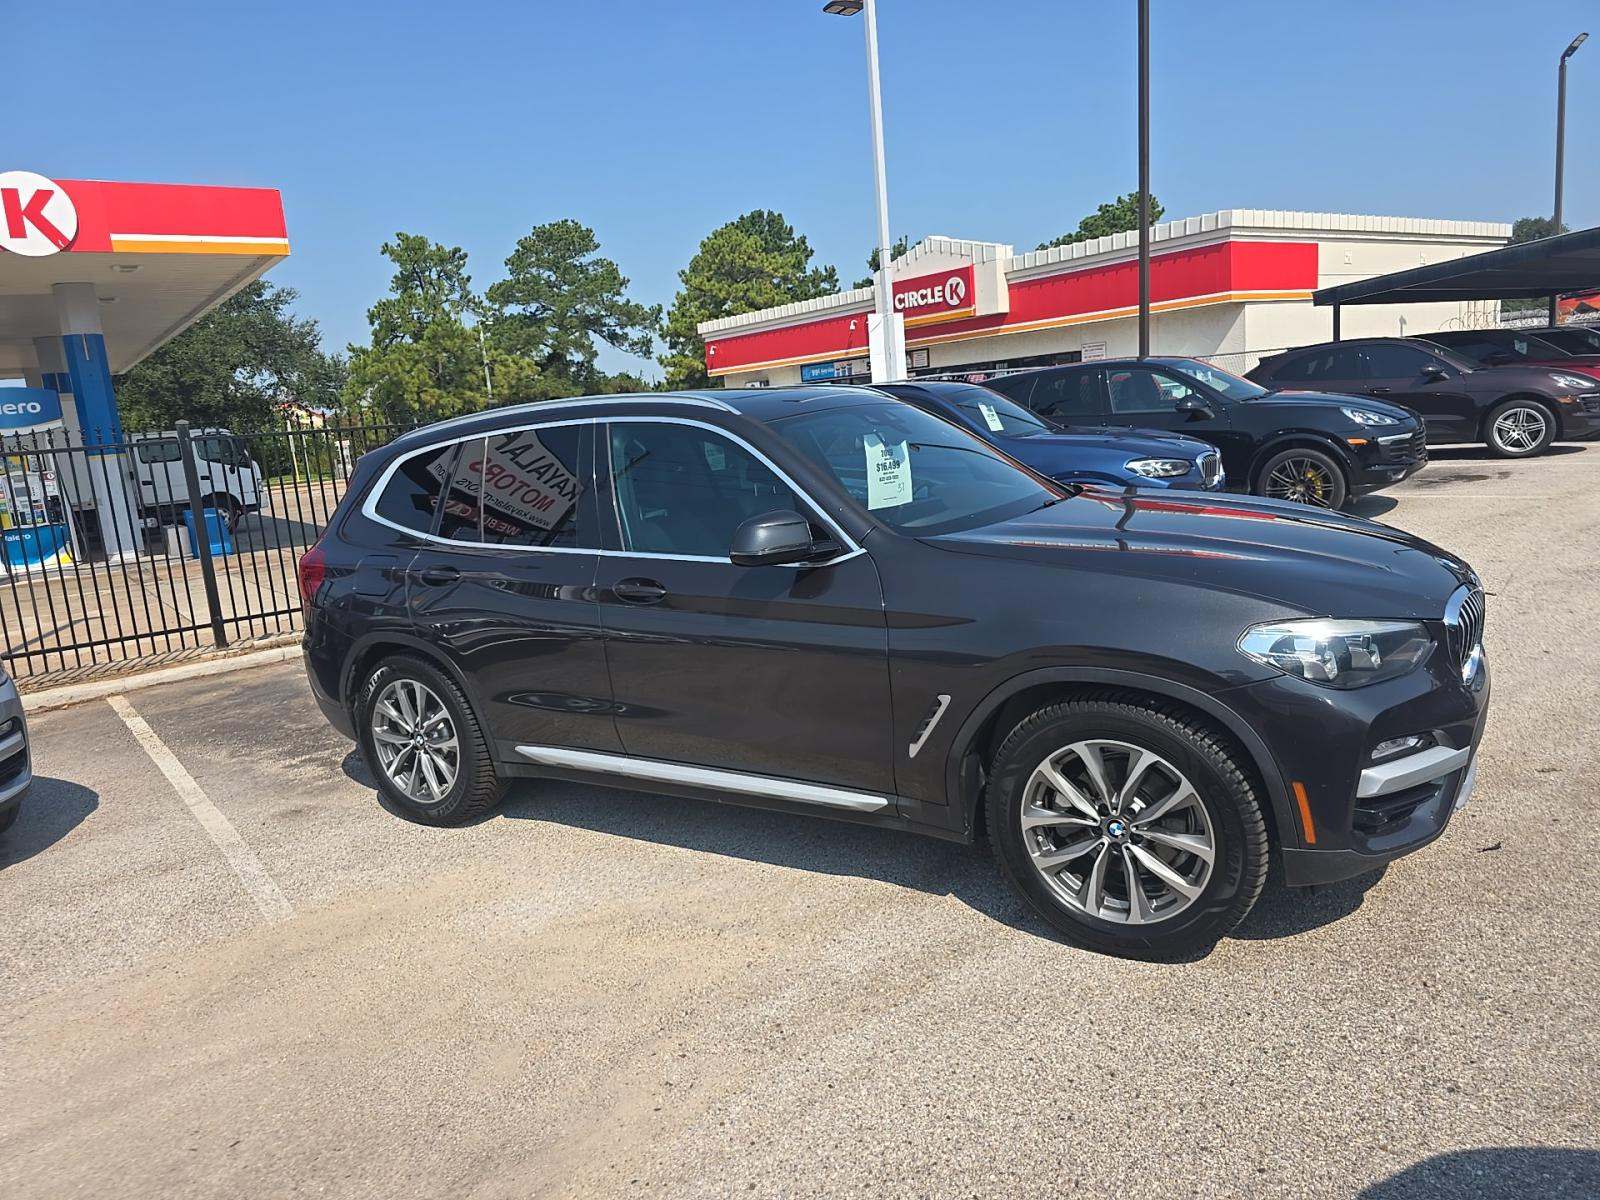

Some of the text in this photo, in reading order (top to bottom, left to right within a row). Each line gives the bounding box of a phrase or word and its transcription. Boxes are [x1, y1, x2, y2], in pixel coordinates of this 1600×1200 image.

[1, 188, 71, 251] K
[895, 281, 964, 310] CIRCLE K
[0, 402, 41, 415] ero
